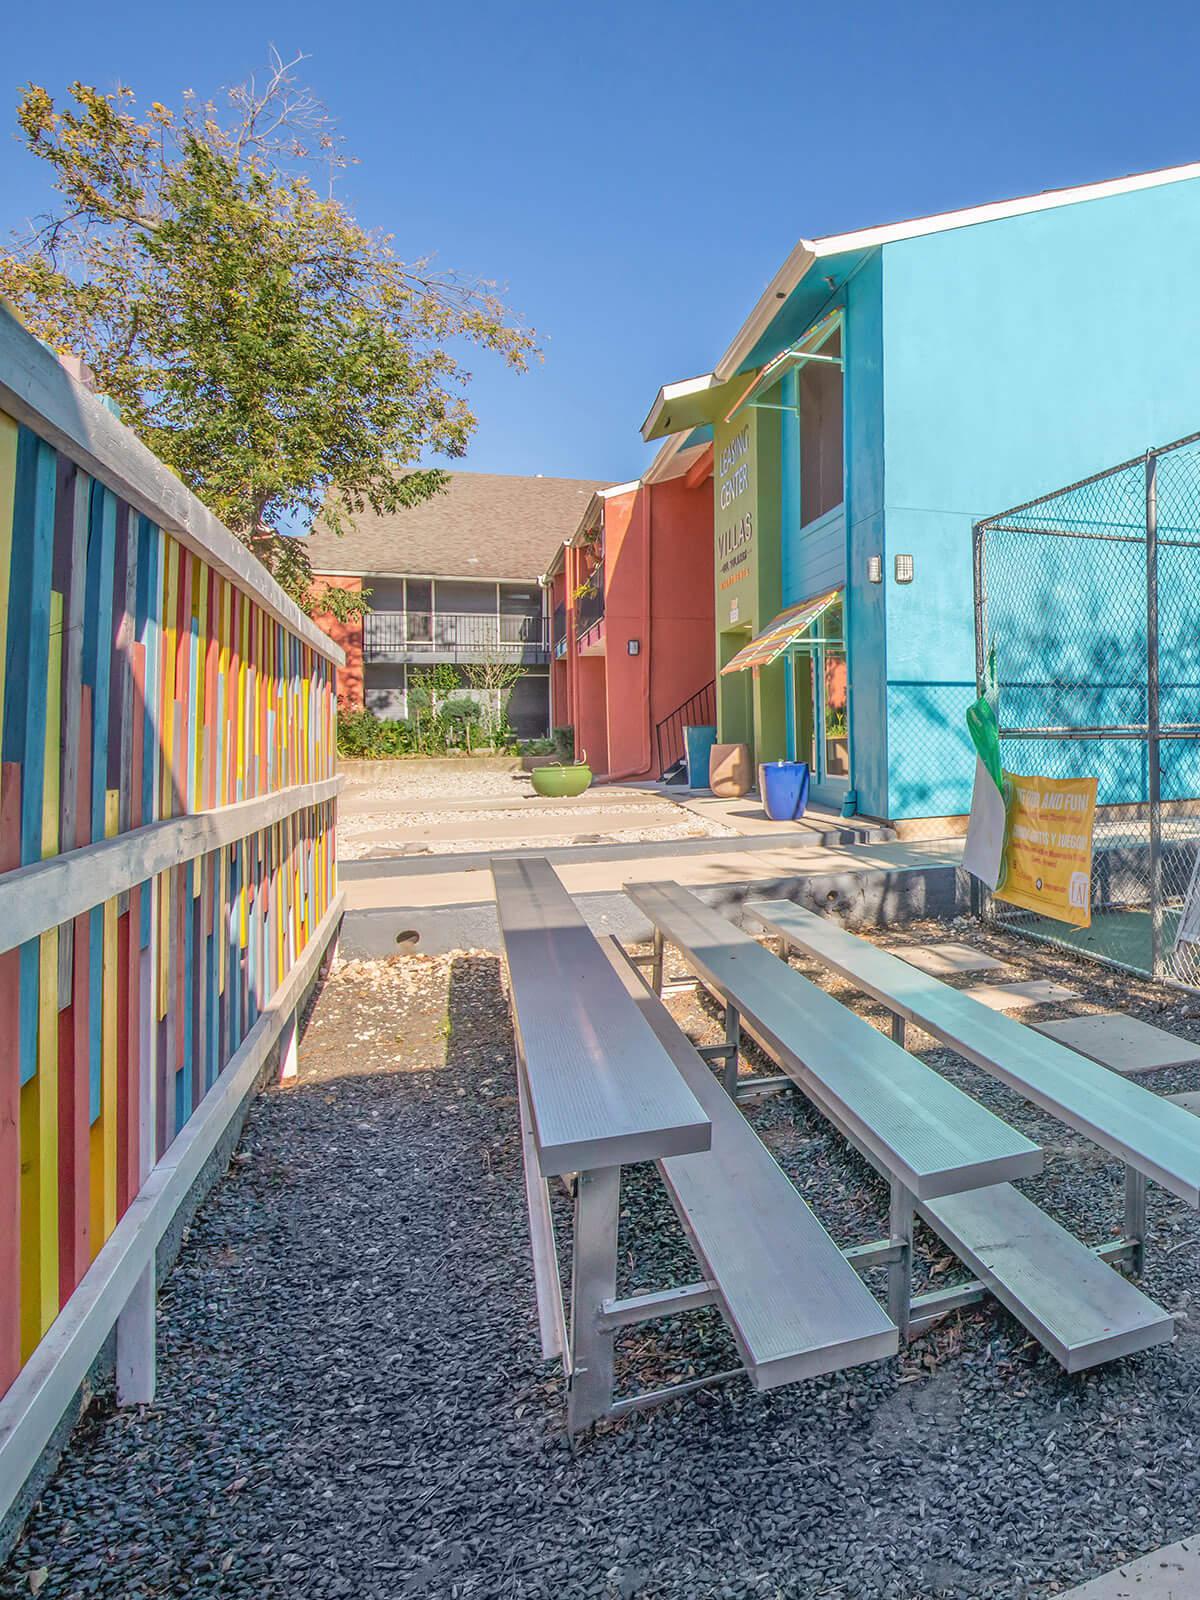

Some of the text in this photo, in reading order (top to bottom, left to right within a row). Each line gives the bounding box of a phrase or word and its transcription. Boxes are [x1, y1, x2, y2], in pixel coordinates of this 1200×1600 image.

[719, 424, 749, 477] LEASING
[720, 463, 749, 510] CENTER
[718, 512, 753, 561] VILLAS
[1042, 793, 1063, 811] AND
